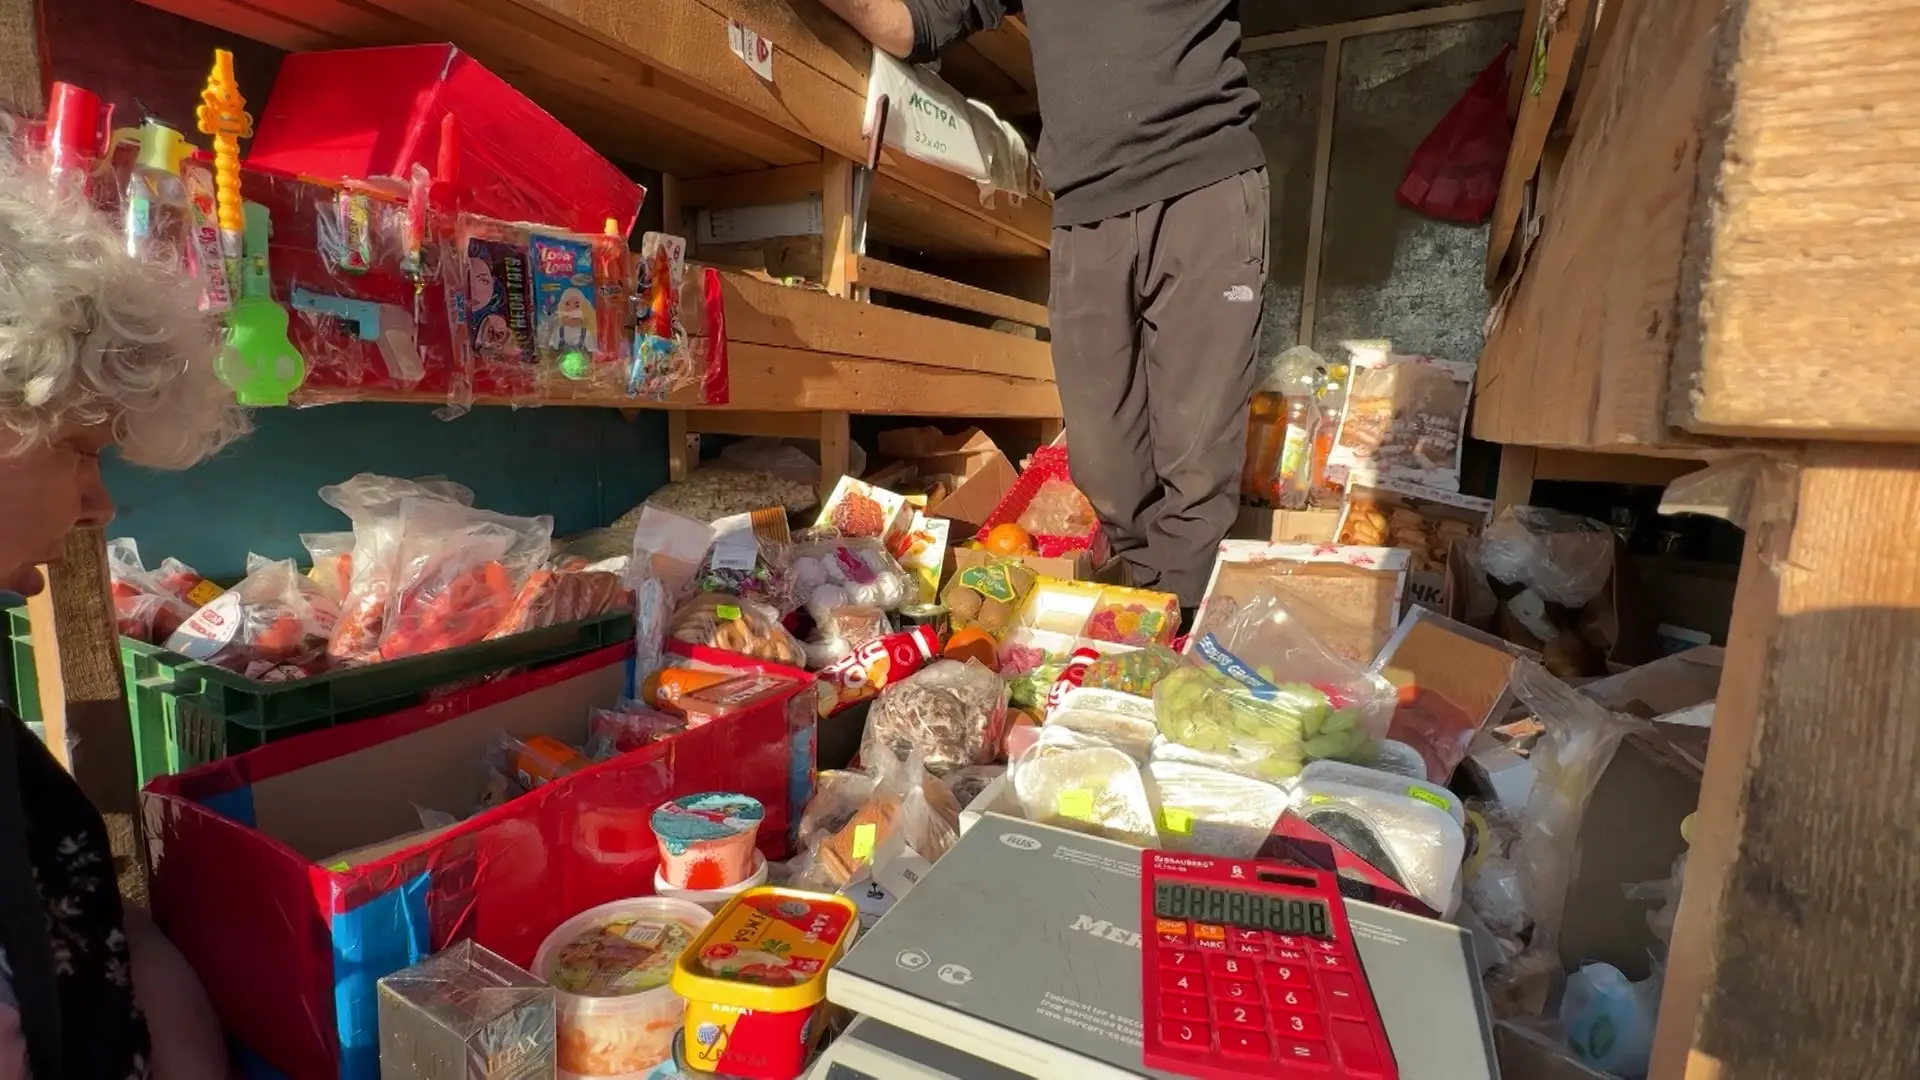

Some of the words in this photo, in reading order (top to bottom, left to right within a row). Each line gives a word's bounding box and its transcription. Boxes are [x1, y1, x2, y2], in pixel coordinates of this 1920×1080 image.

[1226, 960, 1238, 973] 8
[1279, 967, 1292, 980] 9
[1177, 976, 1189, 989] 4
[1284, 991, 1298, 1005] 6
[1233, 1008, 1247, 1022] 2
[1289, 1016, 1304, 1031] 3
